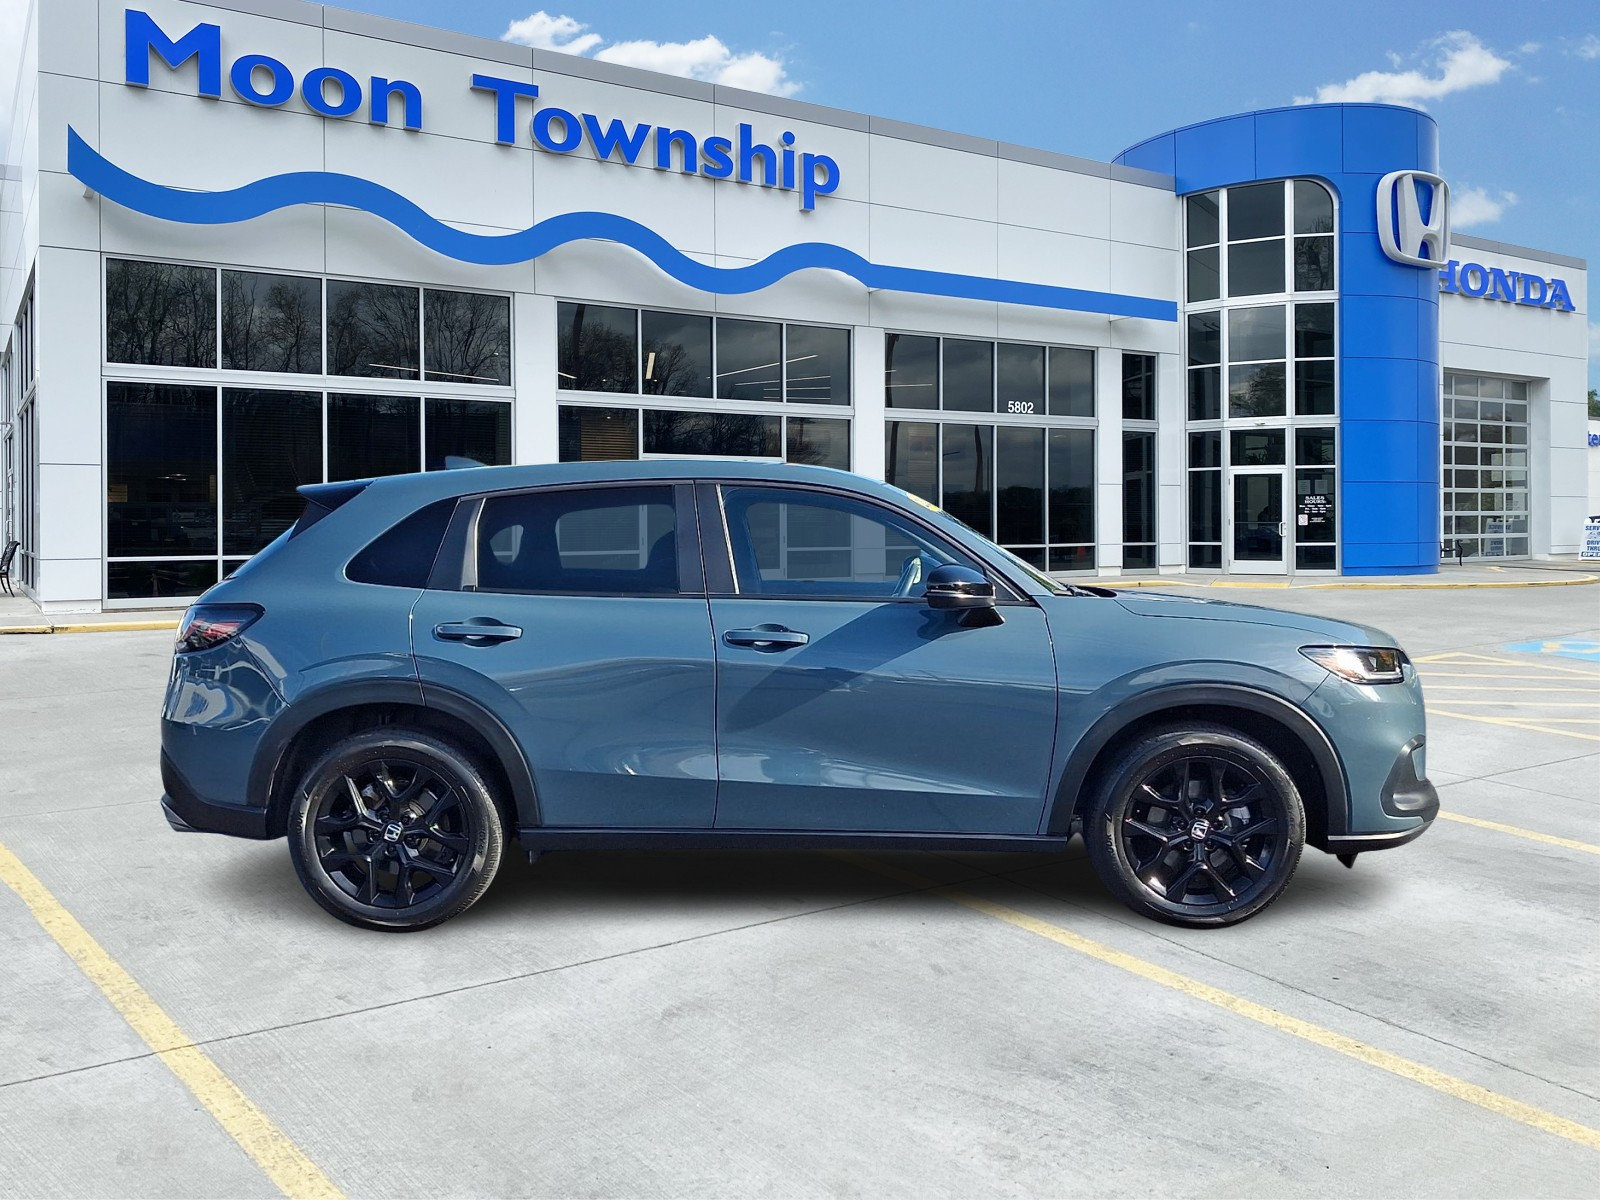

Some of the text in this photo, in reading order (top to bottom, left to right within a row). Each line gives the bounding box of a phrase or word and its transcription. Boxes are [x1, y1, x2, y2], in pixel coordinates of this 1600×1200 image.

[125, 9, 841, 213] Moon Township
[1007, 400, 1034, 414] 5802
